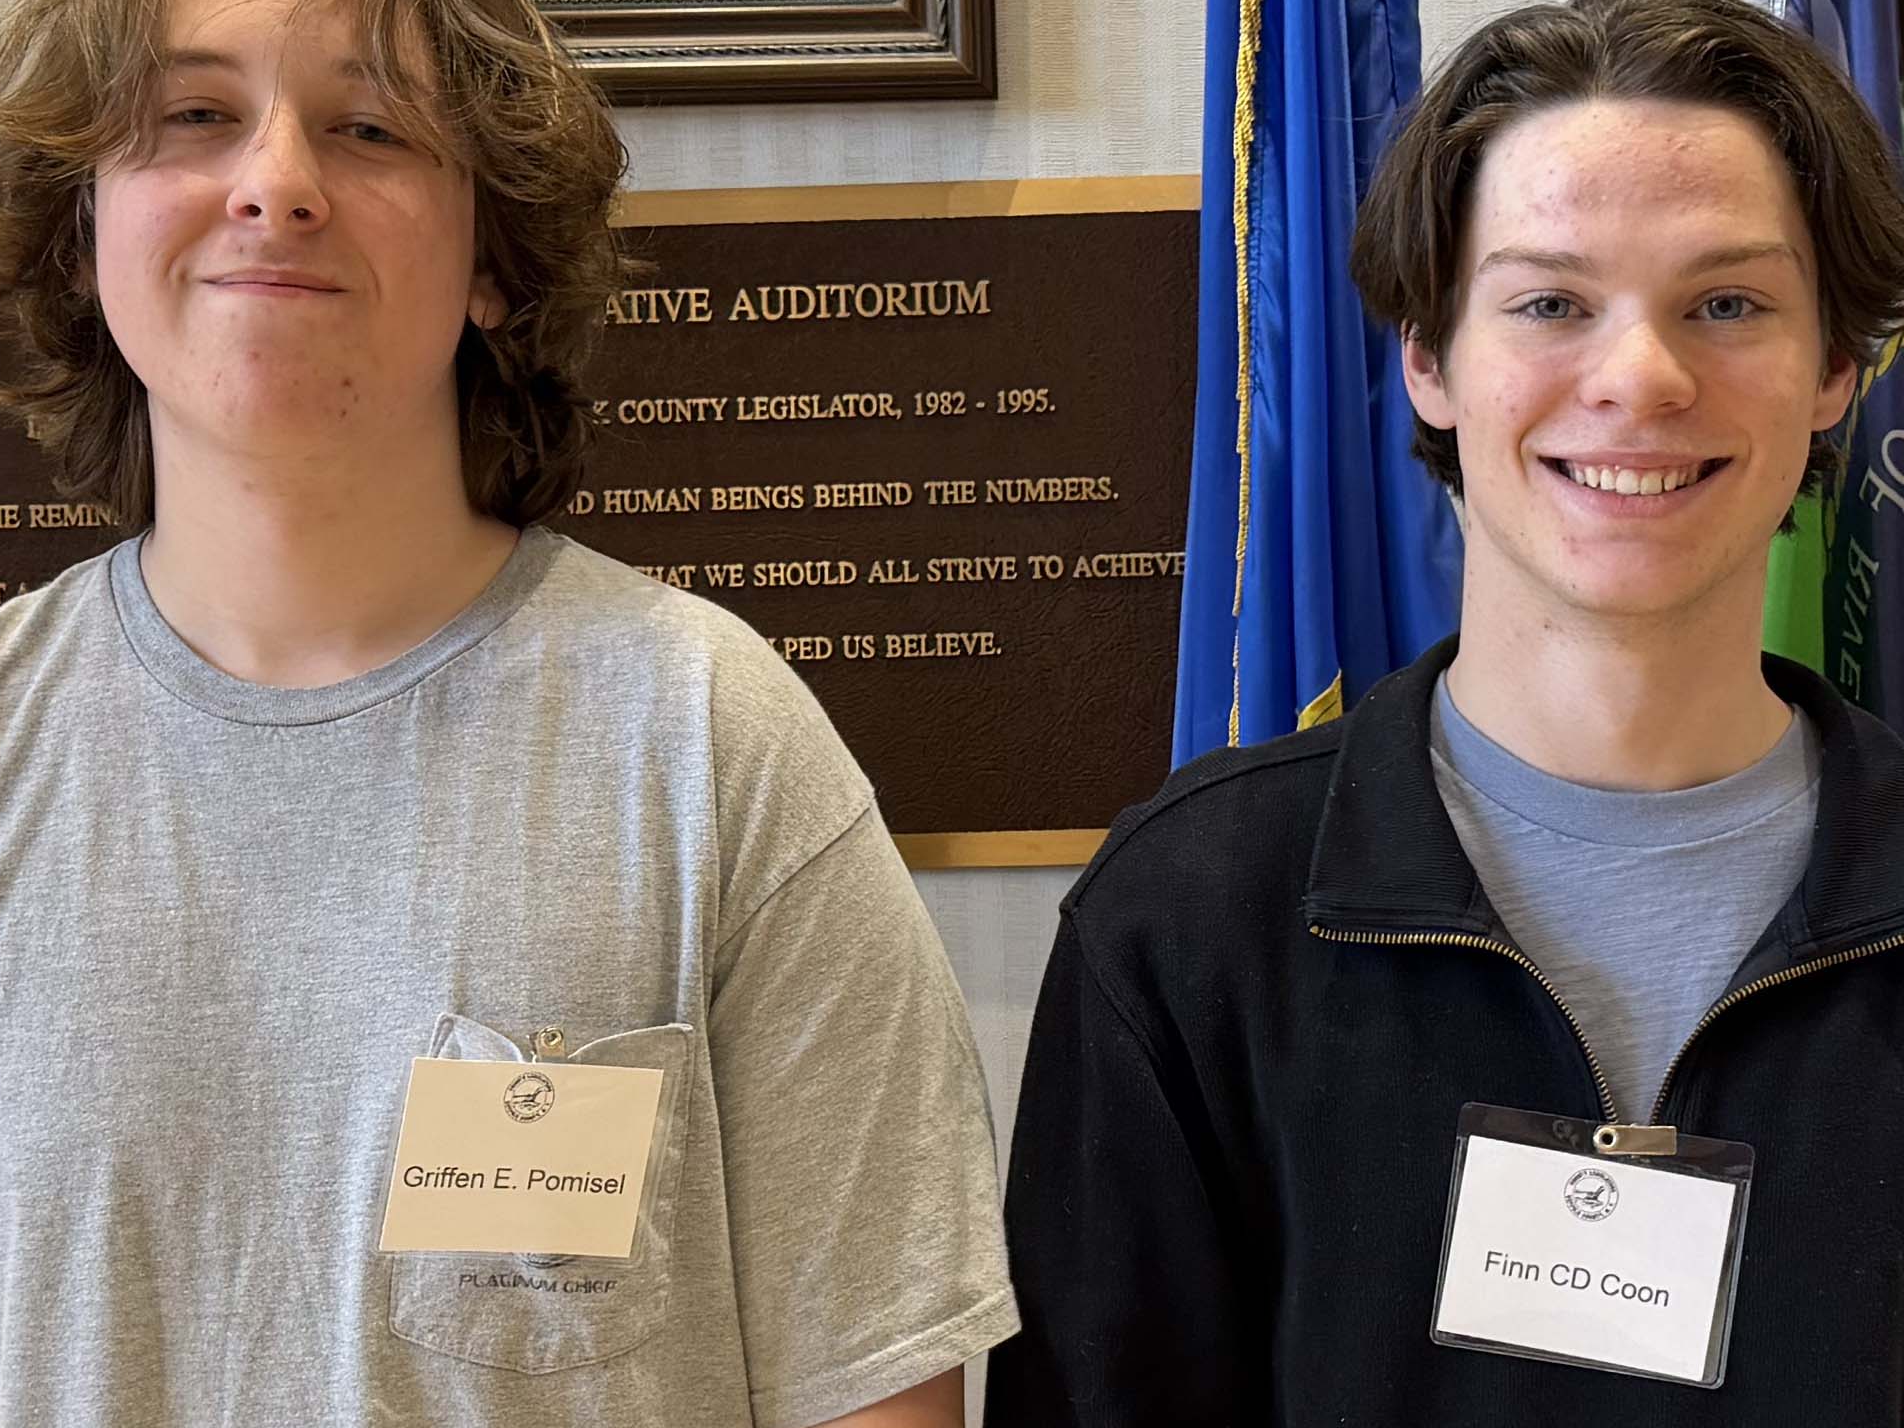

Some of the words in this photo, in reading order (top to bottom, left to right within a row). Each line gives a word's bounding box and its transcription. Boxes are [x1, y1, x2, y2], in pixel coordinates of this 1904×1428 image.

[603, 288, 713, 325] ATIVE
[728, 279, 992, 322] AUDITORIUM
[618, 397, 729, 424] COUNTY
[736, 393, 903, 421] LEGISLATOR,
[913, 390, 967, 416] 1982
[996, 387, 1057, 414] 1995.
[28, 502, 120, 529] REMIN
[603, 486, 701, 515] HUMAN
[711, 484, 805, 511] BEINGS
[813, 481, 913, 509] BEHIND
[924, 480, 977, 505] THE
[985, 476, 1120, 503] NUMBERS.
[704, 563, 746, 588] WE
[753, 560, 857, 587] SHOULD
[867, 559, 920, 584] ALL
[926, 556, 1019, 582] STRIVE
[1028, 555, 1065, 580] TO
[767, 636, 833, 661] PED
[842, 635, 876, 659] US
[885, 631, 1003, 658] BELIEVE.
[402, 1165, 485, 1189] Griffen
[493, 1169, 518, 1191] E.
[526, 1169, 627, 1195] Pomisel
[1484, 1250, 1541, 1282] Finn
[1550, 1263, 1592, 1290] CD
[1600, 1273, 1671, 1307] Coon
